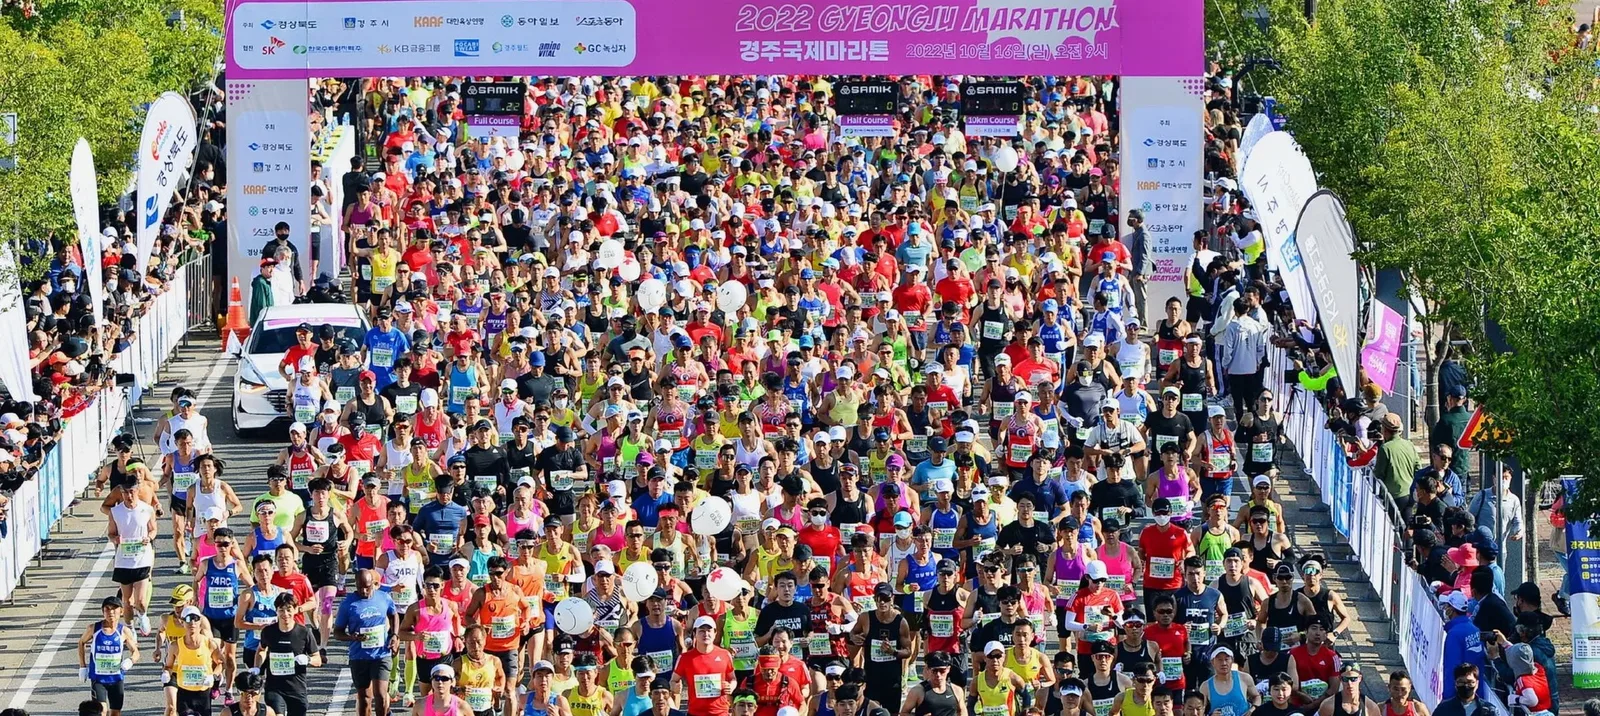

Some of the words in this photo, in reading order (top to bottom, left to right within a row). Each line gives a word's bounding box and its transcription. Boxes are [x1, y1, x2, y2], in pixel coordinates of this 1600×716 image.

[414, 16, 444, 28] KAAF
[517, 17, 560, 26] 동아일보
[576, 17, 624, 26] 스포츠동아
[735, 4, 815, 32] 2022
[818, 4, 959, 33] GYEONGJU
[961, 5, 1117, 33] MARATHON
[278, 20, 318, 29] 경상북도
[262, 46, 276, 55] SK
[538, 42, 561, 50] amino
[739, 40, 890, 62] 경주국제마라톤
[905, 42, 957, 59] 2022년
[959, 42, 991, 59] 10월
[994, 42, 1051, 61] 16일(일)
[1054, 42, 1082, 59] 오전
[1085, 42, 1109, 59] 9시
[478, 86, 519, 94] SAMIK
[850, 85, 892, 94] SAMIK
[976, 85, 1018, 94] SAMIK
[474, 117, 488, 125] Full
[488, 117, 515, 125] Course
[846, 116, 864, 124] Half
[864, 116, 889, 124] Course
[968, 116, 988, 124] 10km
[989, 116, 1015, 124] Course
[262, 143, 293, 151] 경상북도
[1156, 139, 1188, 147] 경상북도
[157, 126, 189, 187] 경상북도
[243, 184, 267, 194] KAAF
[1137, 181, 1161, 190] KAAF
[261, 207, 294, 215] 동아일보
[1154, 203, 1188, 212] 동아일보
[254, 227, 275, 237] 스포츠
[1152, 246, 1188, 254] 북도육상연맹
[210, 576, 231, 586] 74RC
[1185, 608, 1209, 618] PRC
